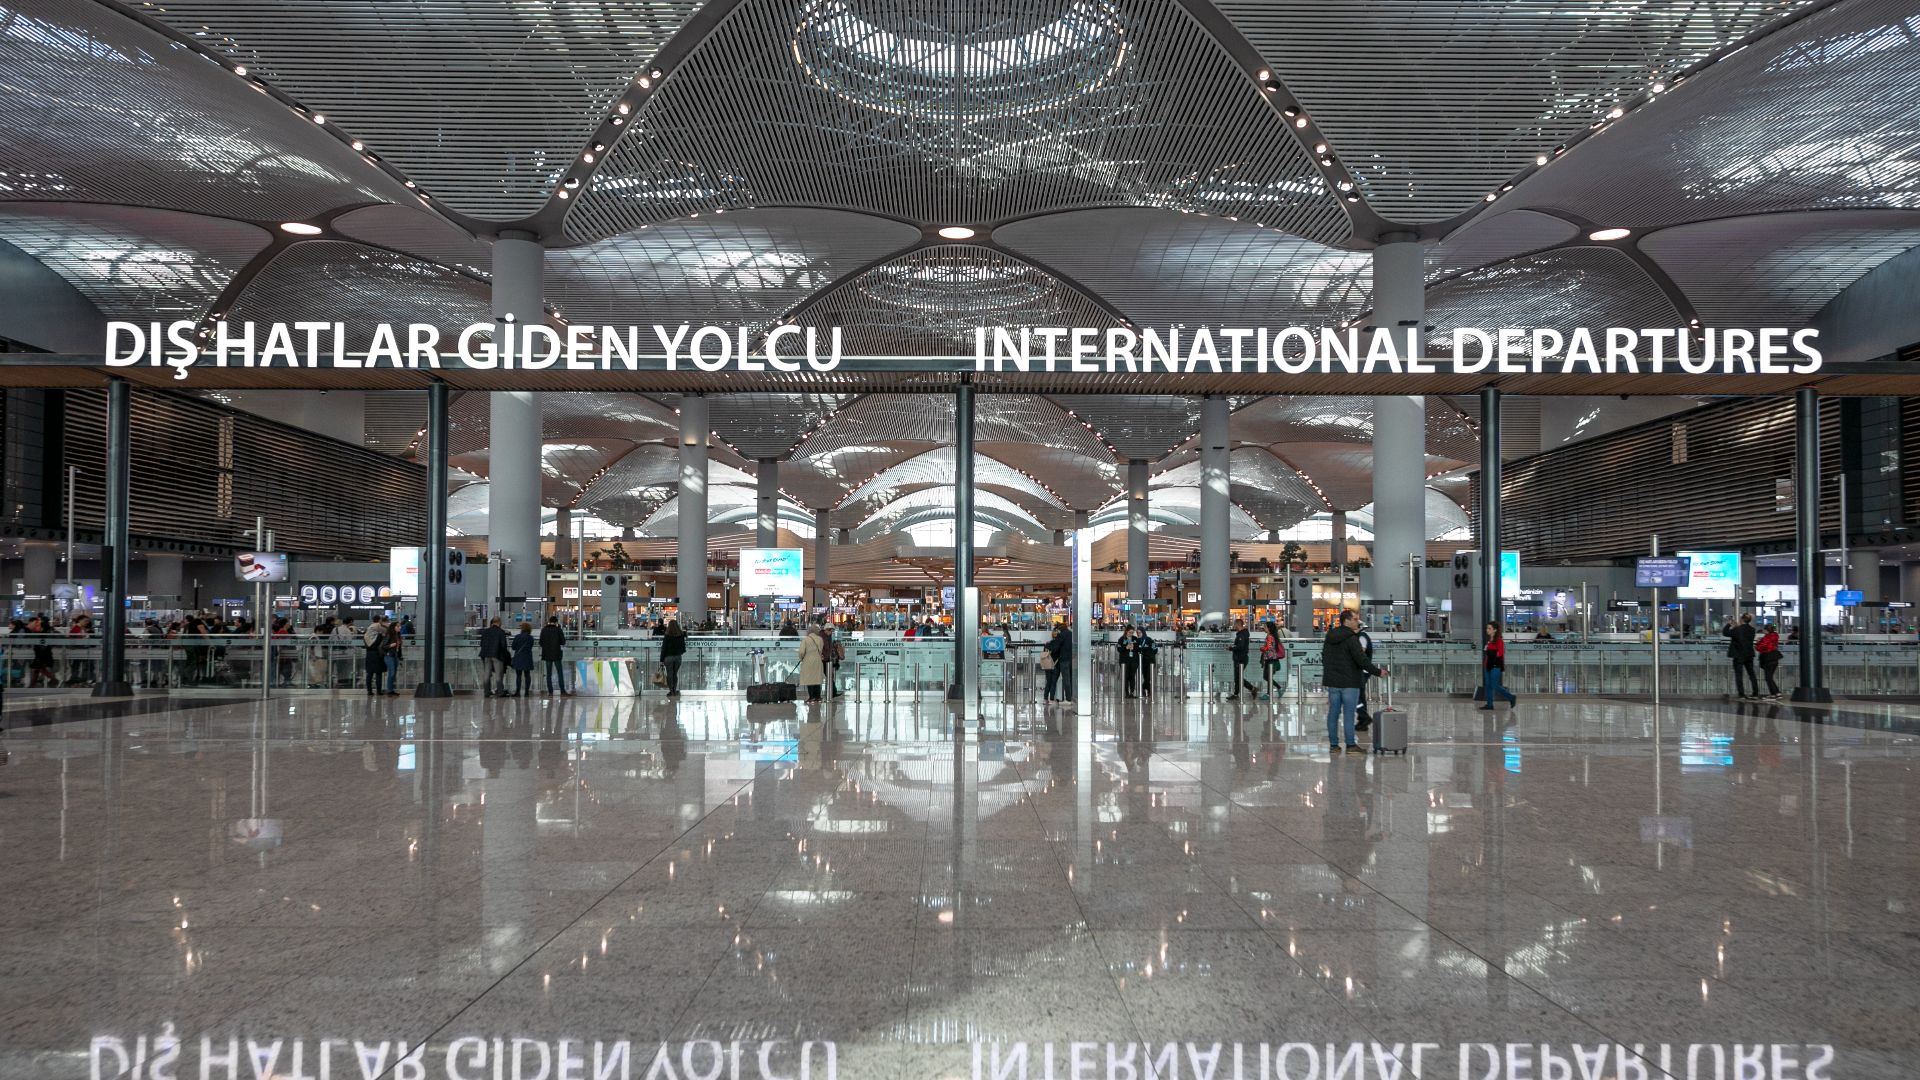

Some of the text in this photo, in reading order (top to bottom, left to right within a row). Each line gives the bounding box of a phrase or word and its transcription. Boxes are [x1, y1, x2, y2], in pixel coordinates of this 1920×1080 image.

[105, 311, 844, 379] DIŞ HATLAR GİDEN YOLCU
[975, 325, 1821, 375] INTERNATIONAL DEPARTURES
